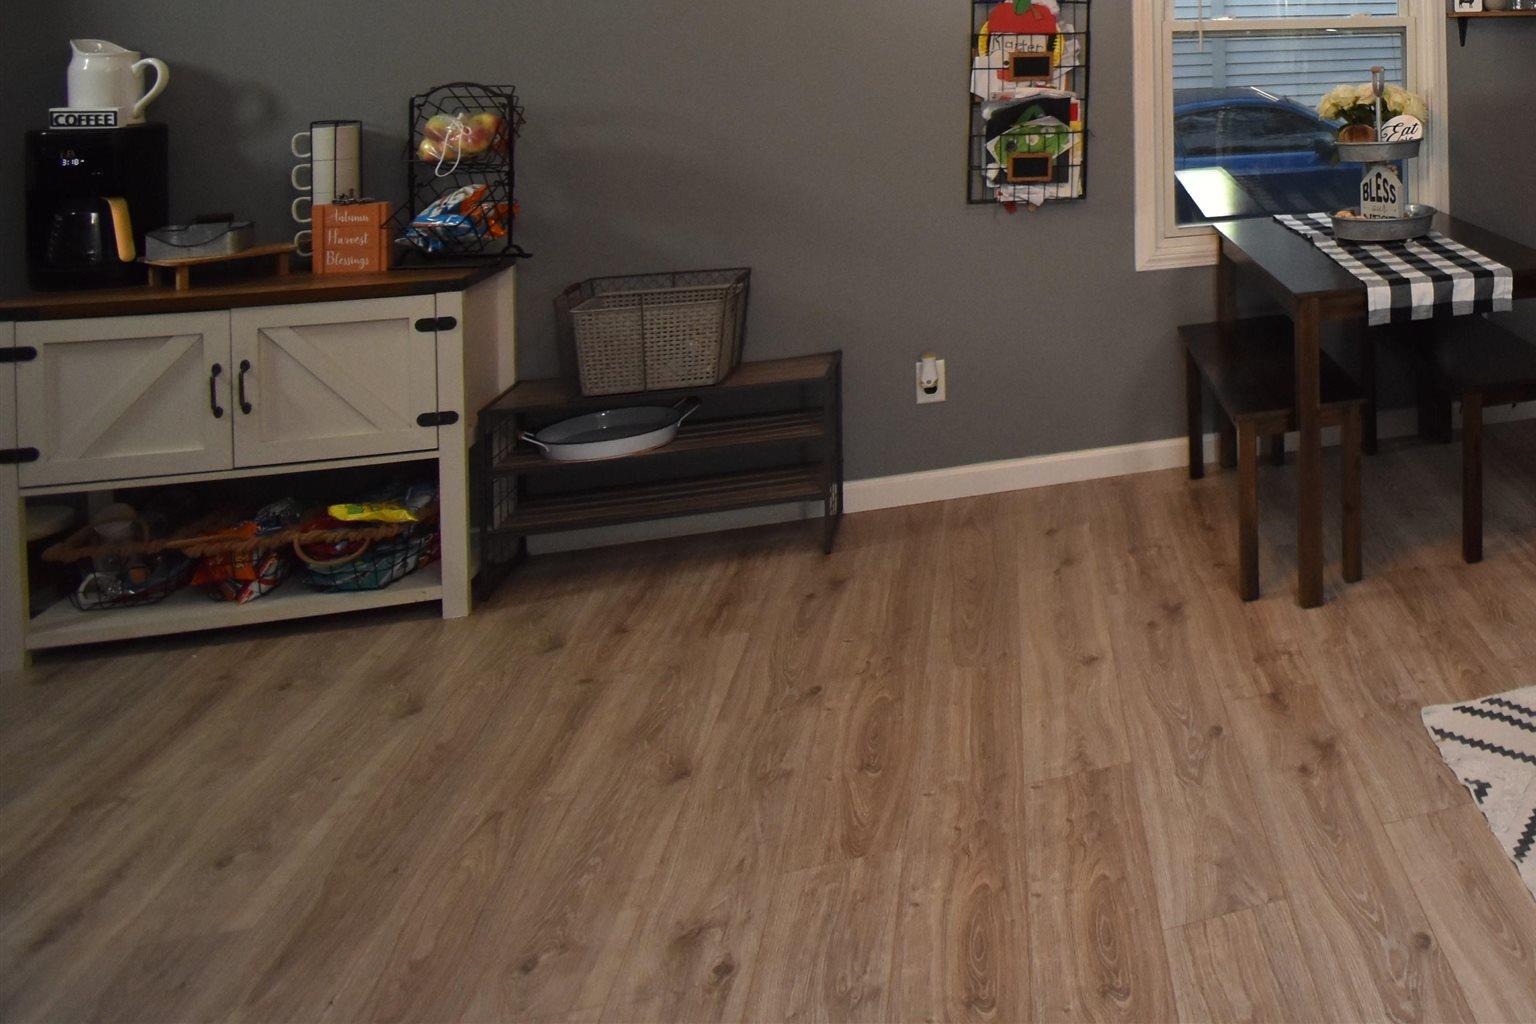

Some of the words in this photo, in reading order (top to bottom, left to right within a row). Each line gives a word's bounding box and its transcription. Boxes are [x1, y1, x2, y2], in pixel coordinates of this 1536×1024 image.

[54, 113, 114, 127] COFFEE
[1381, 122, 1419, 142] Eat
[1362, 172, 1397, 204] BLESS
